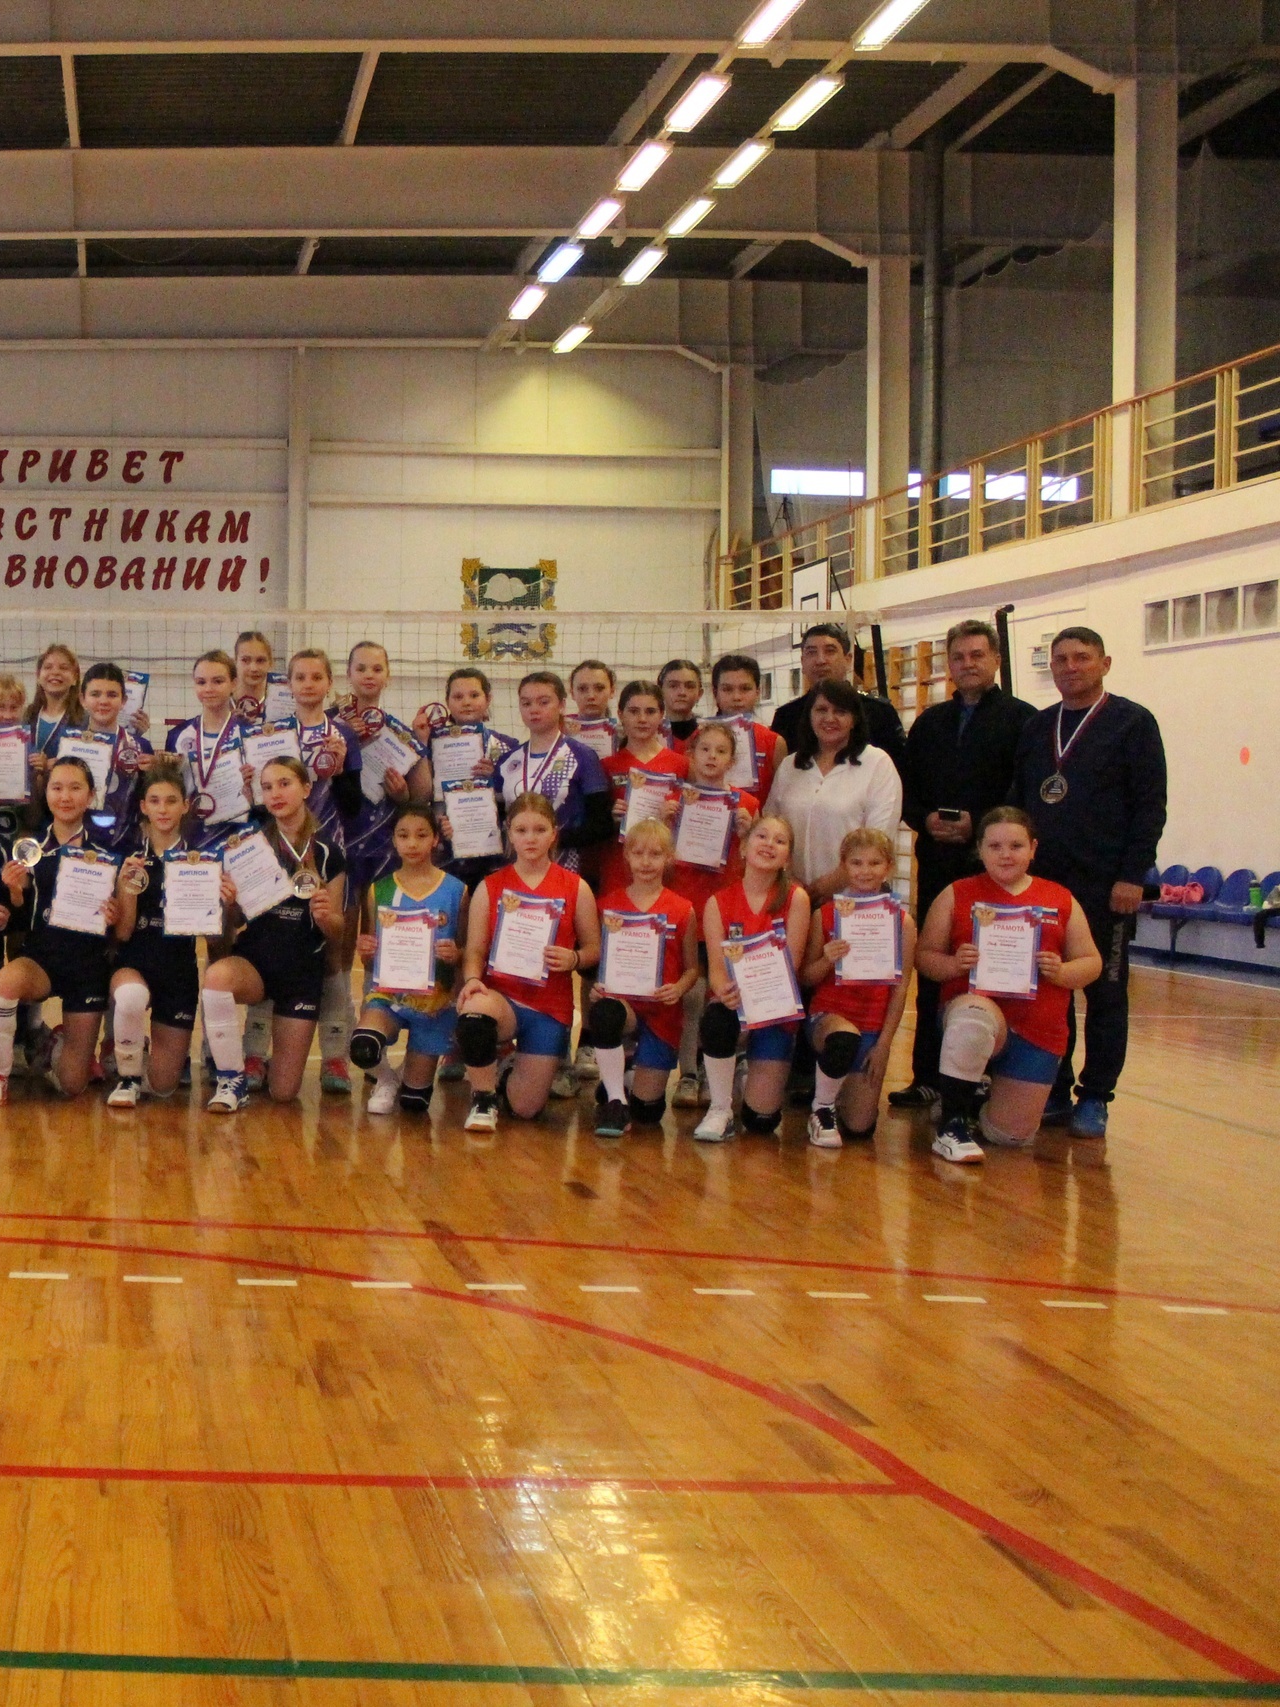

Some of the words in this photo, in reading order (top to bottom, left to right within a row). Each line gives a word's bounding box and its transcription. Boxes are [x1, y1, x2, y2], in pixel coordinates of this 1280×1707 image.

[257, 739, 285, 750] ДИПЛОМ
[443, 741, 470, 749] ДИПЛОМ
[71, 747, 100, 756] ДИПЛОМ
[457, 796, 484, 804] ДИПЛОМ
[696, 804, 723, 813] ГРАМОТА
[72, 866, 103, 877] ДИПЛОМ
[516, 912, 544, 923] ГРАМОТА
[621, 931, 651, 939] ГРАМОТА
[745, 951, 775, 963] ГРАМОТА
